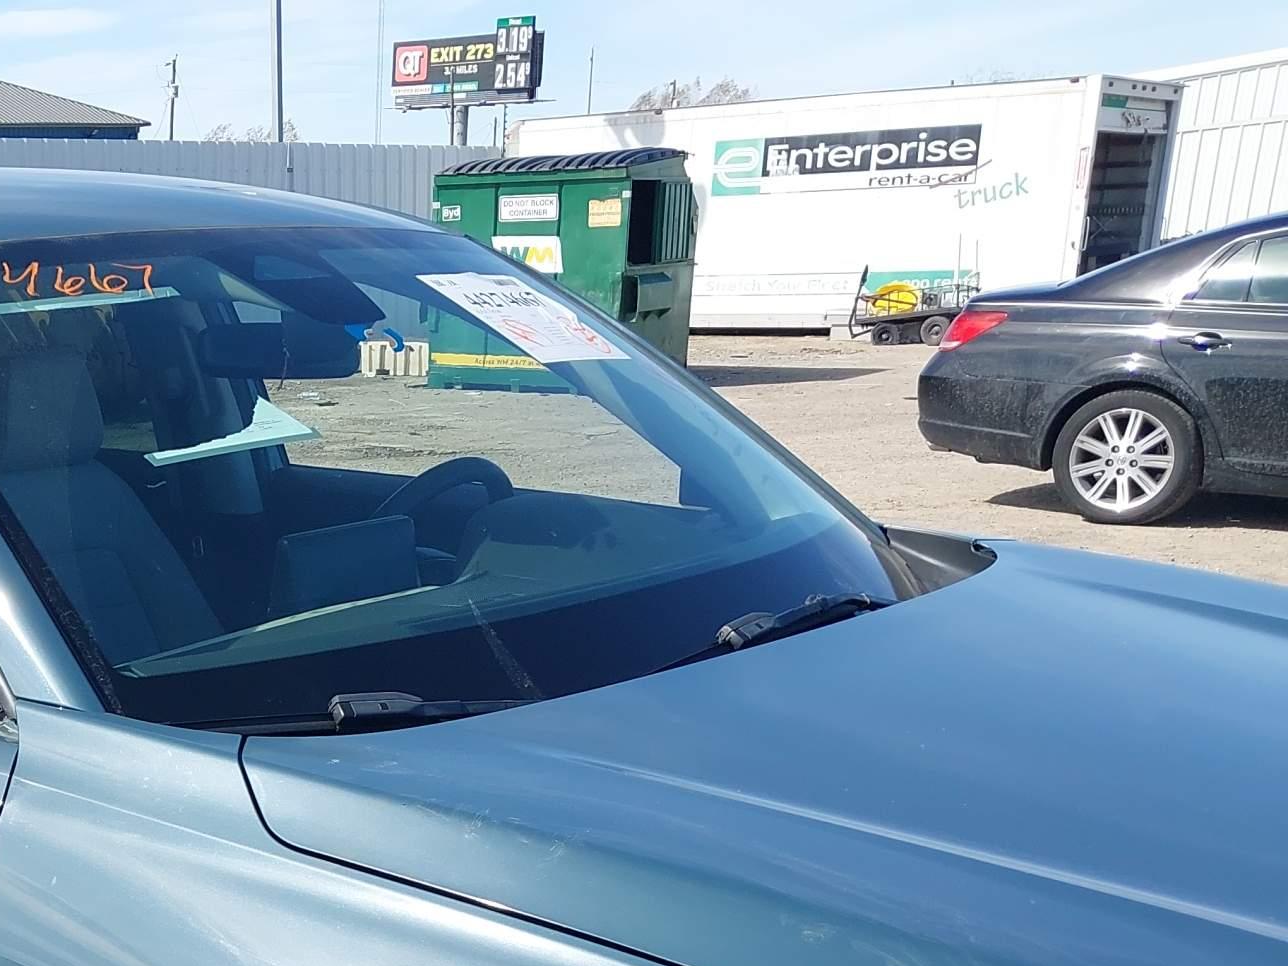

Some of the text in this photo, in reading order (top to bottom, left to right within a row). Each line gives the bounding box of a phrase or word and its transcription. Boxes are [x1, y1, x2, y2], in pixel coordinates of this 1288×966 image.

[430, 43, 494, 63] EXIT 273
[398, 51, 423, 77] QT
[456, 64, 478, 74] MILES
[766, 132, 977, 172] Enterprise
[868, 172, 969, 188] rent-a-car
[953, 172, 1030, 208] truck
[501, 246, 554, 264] WM
[463, 291, 547, 307] 44274667
